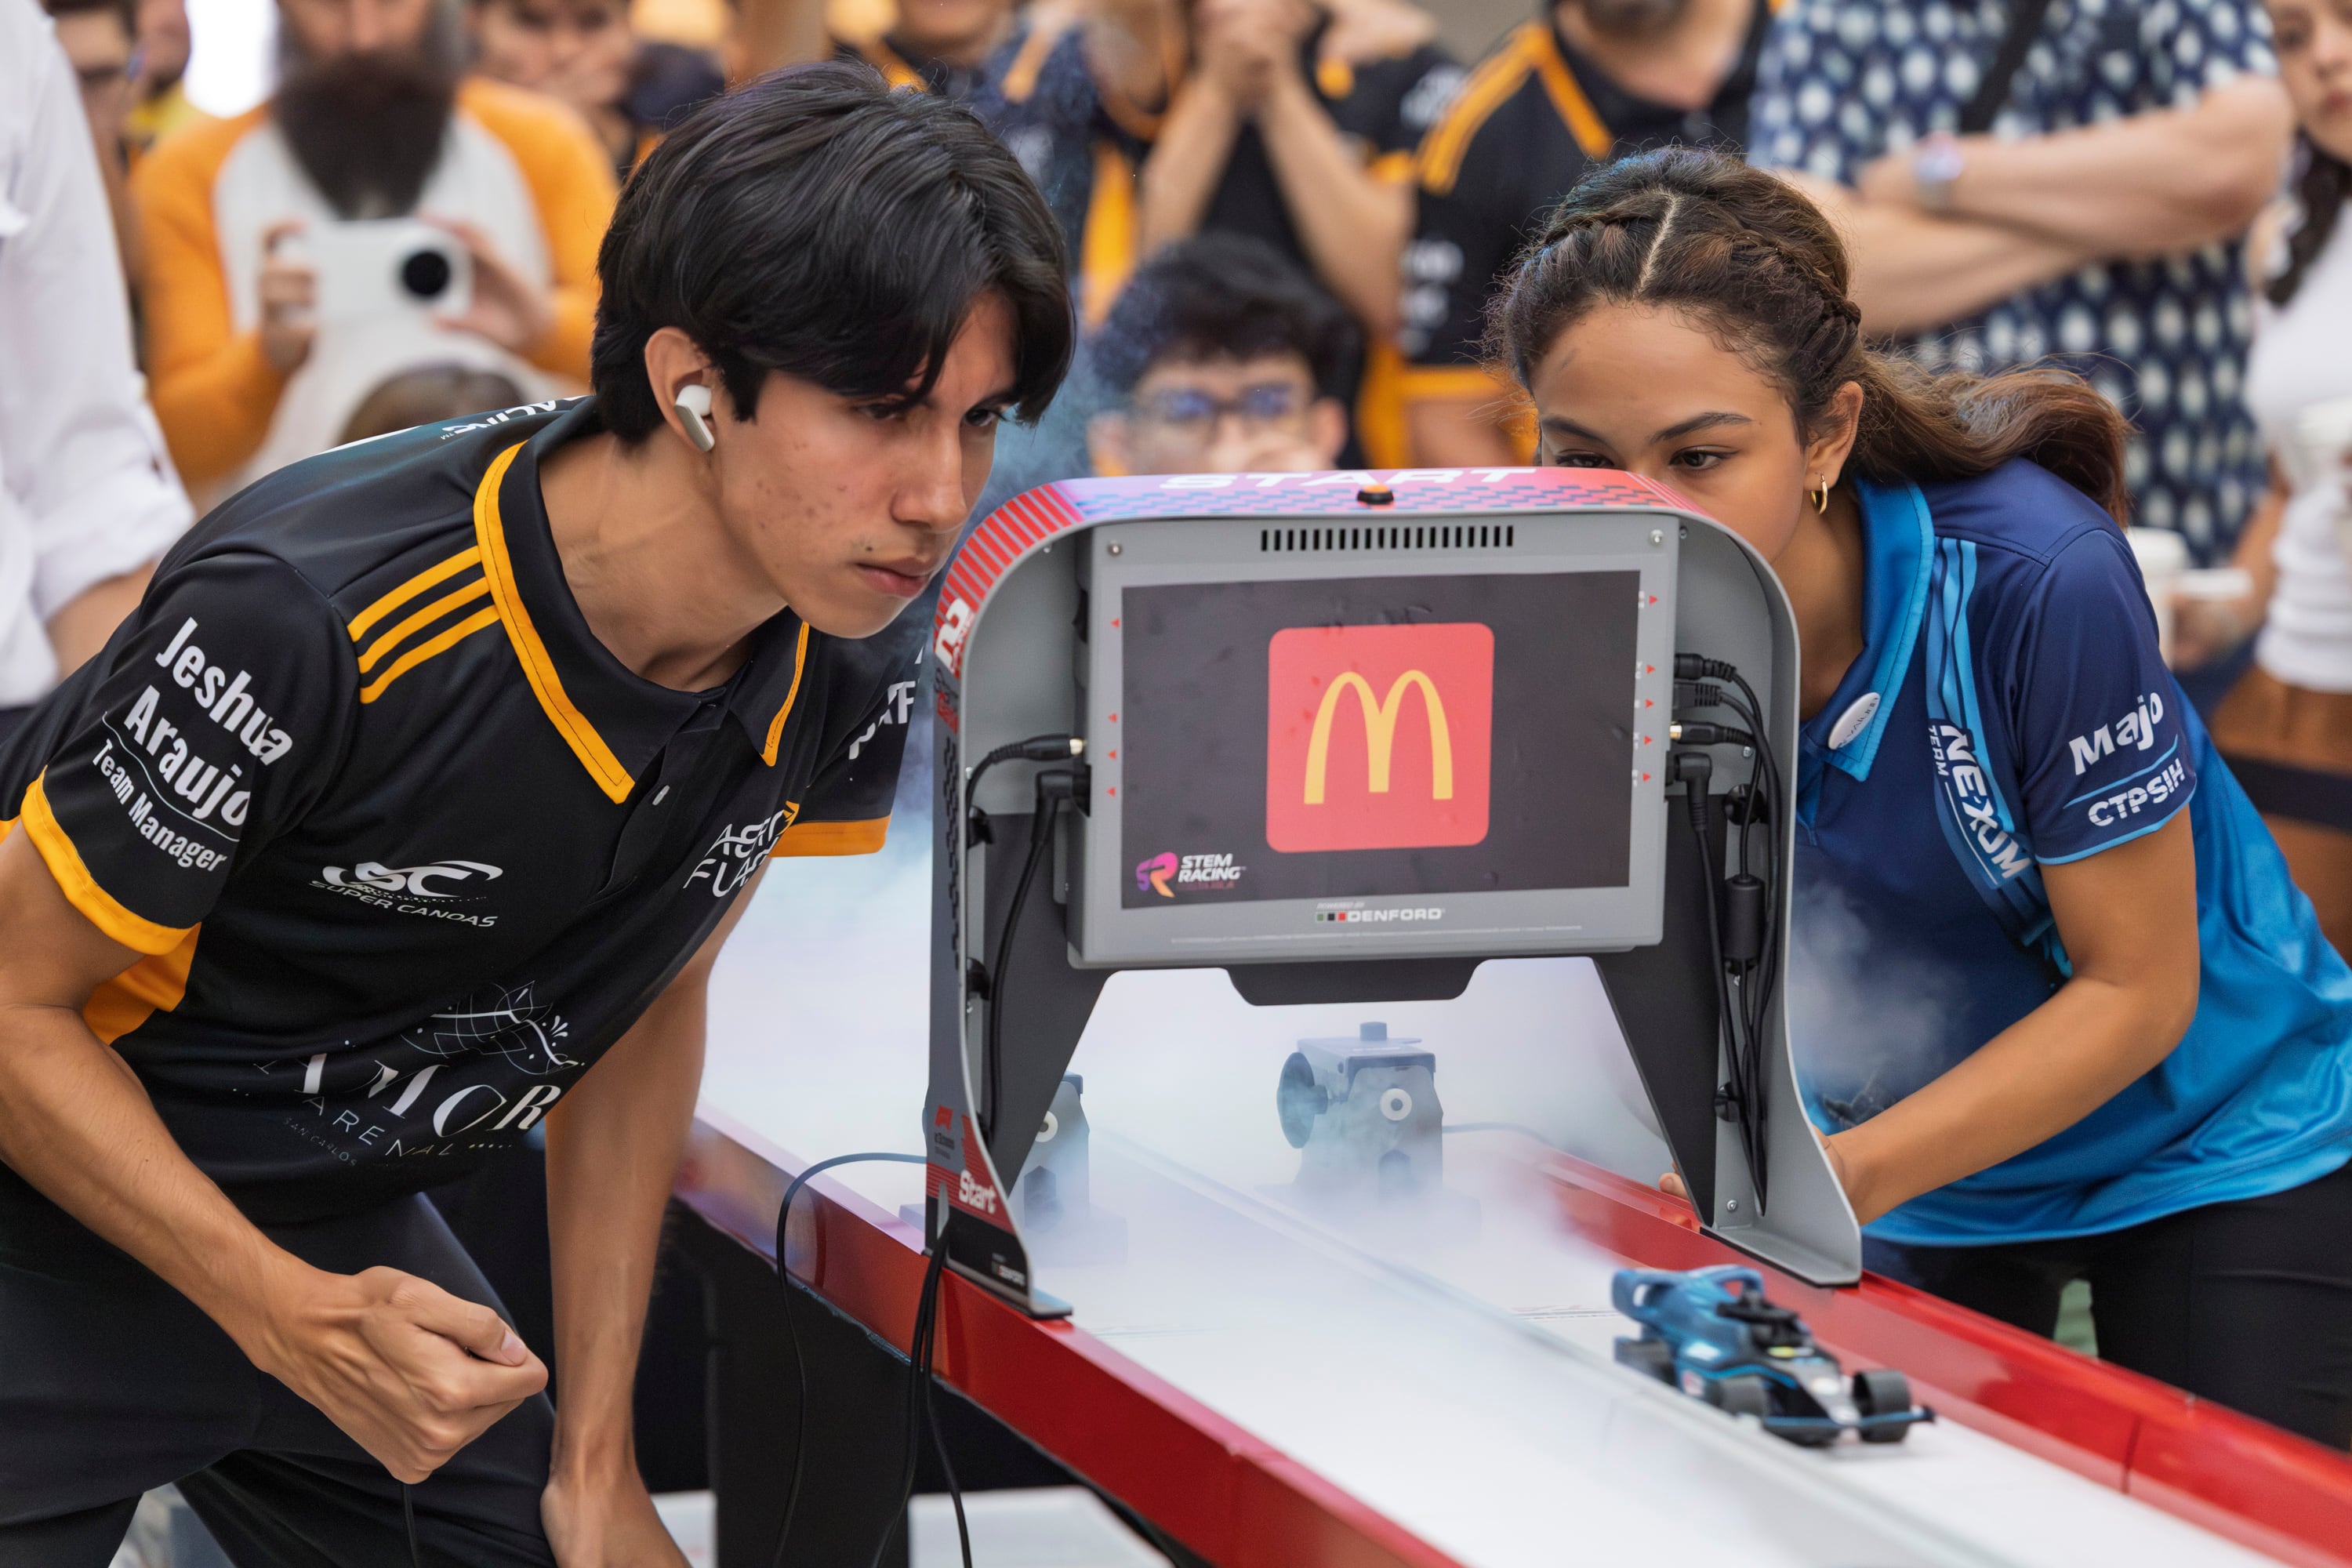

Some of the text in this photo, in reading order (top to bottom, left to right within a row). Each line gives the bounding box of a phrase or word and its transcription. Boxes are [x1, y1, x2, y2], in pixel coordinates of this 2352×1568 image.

[1159, 467, 1537, 489] START
[155, 616, 293, 766] Jeshua
[123, 684, 251, 826] Araujo
[1928, 725, 1949, 776] TEAM
[2068, 692, 2164, 776] Majo
[93, 738, 228, 872] Team Manager
[1940, 725, 2032, 879] NEXUM
[2088, 757, 2186, 827] CTPSIH
[1178, 866, 1241, 883] RACING
[1181, 853, 1233, 869] STEM
[309, 880, 499, 927] SUPER CANOAS
[1347, 907, 1443, 923] DENFORD
[302, 1096, 454, 1158] ARENAL
[958, 1169, 996, 1214] Start
